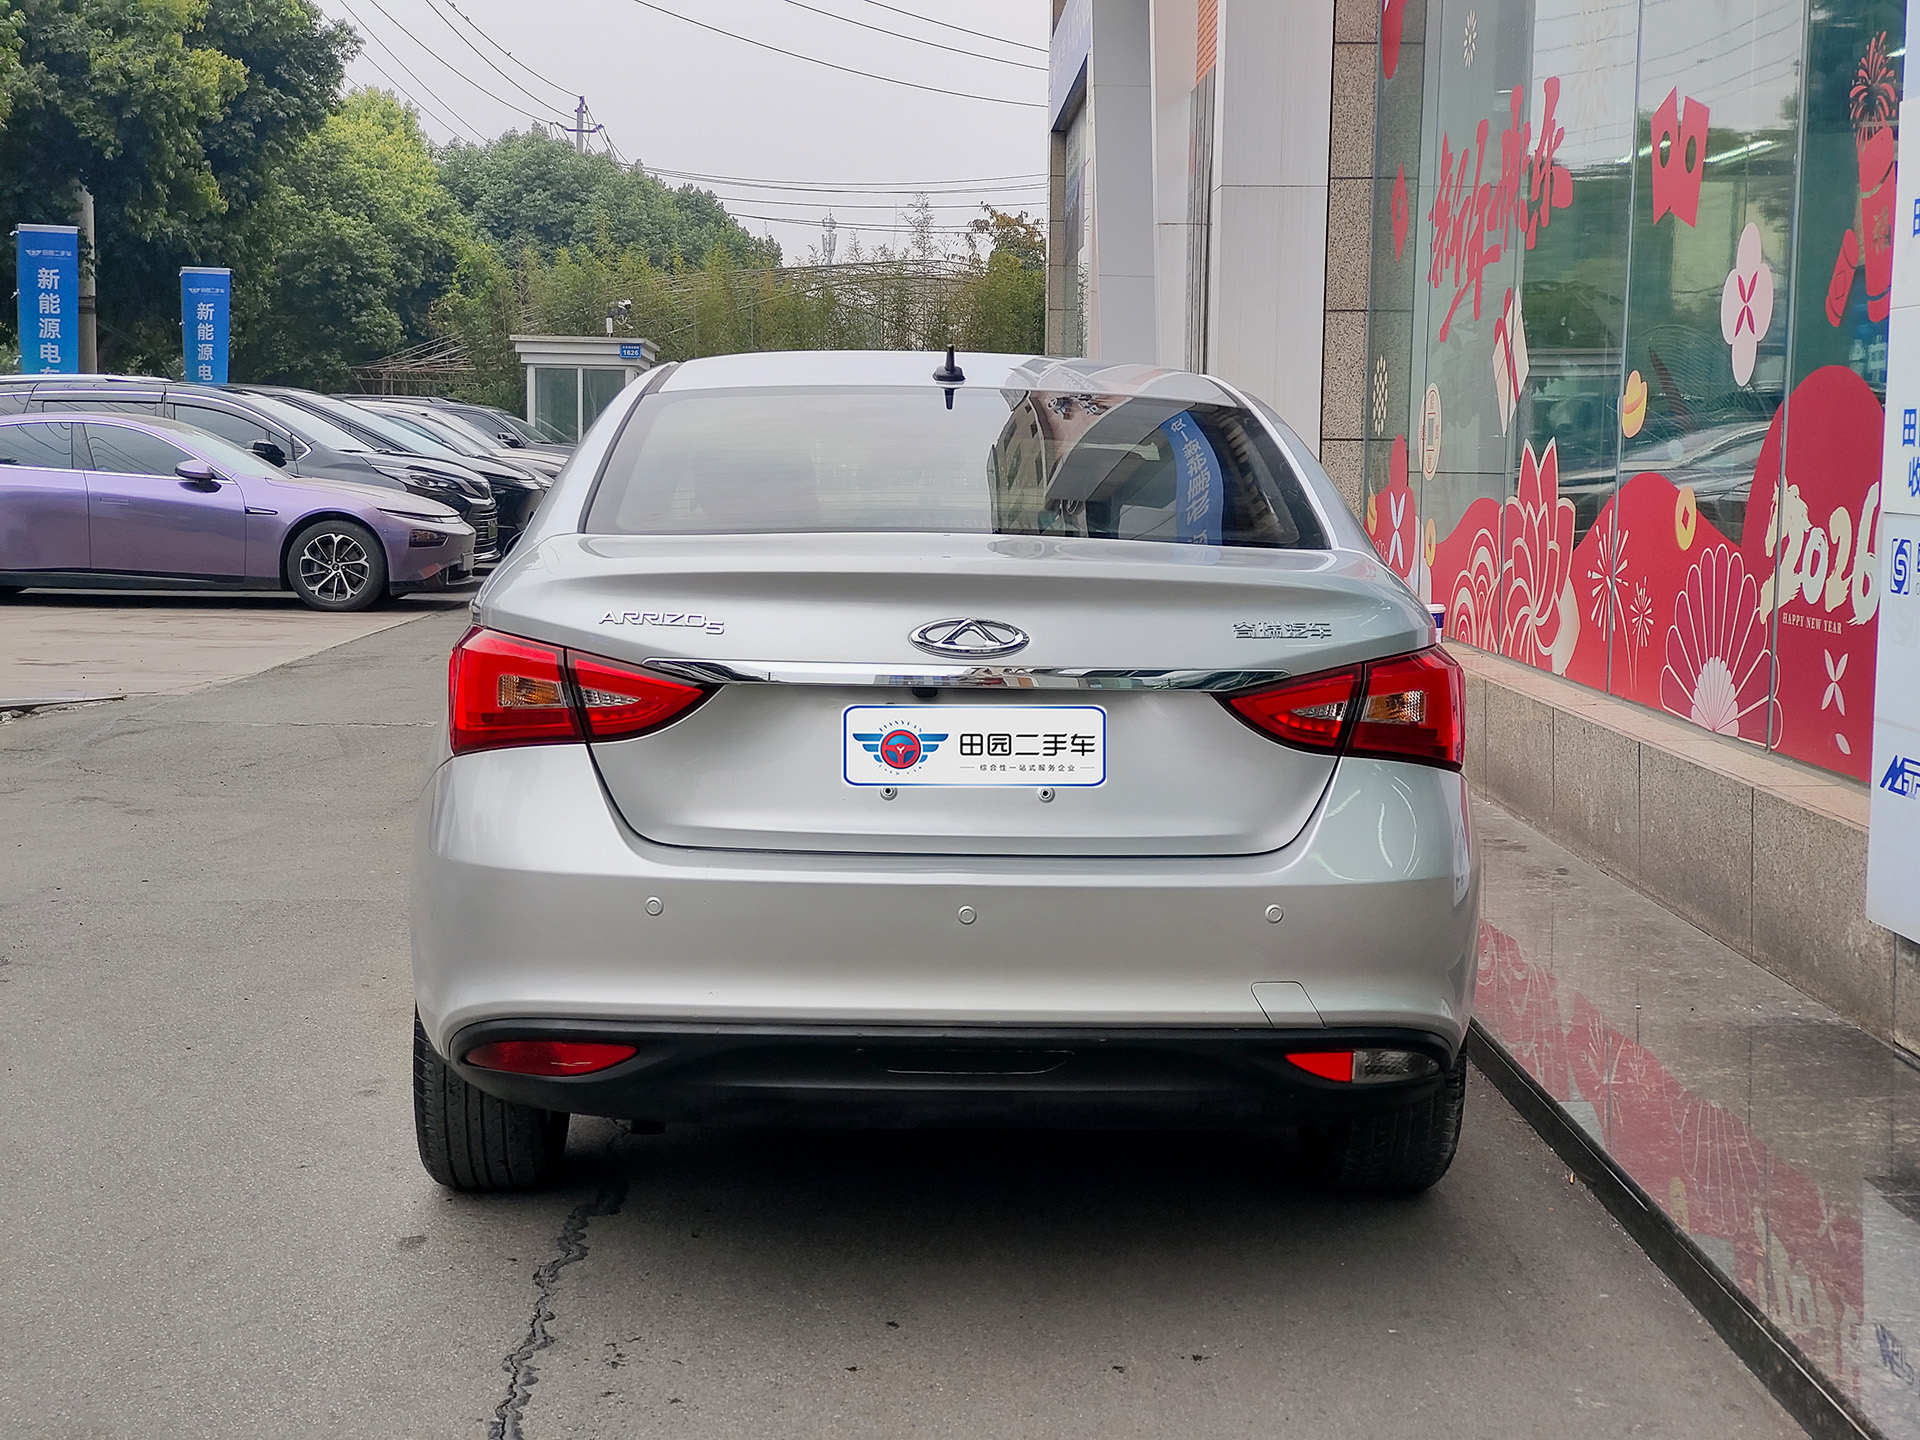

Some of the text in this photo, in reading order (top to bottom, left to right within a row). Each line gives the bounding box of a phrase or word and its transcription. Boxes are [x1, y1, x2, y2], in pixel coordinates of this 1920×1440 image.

[38, 268, 61, 374] 新能源电
[196, 303, 214, 380] 新能源电
[1902, 408, 1920, 447] 田
[1760, 475, 1880, 626] 2026
[1232, 621, 1333, 639] 奇瑞汽车
[1782, 612, 1842, 634] HAPPY NEW YEAR
